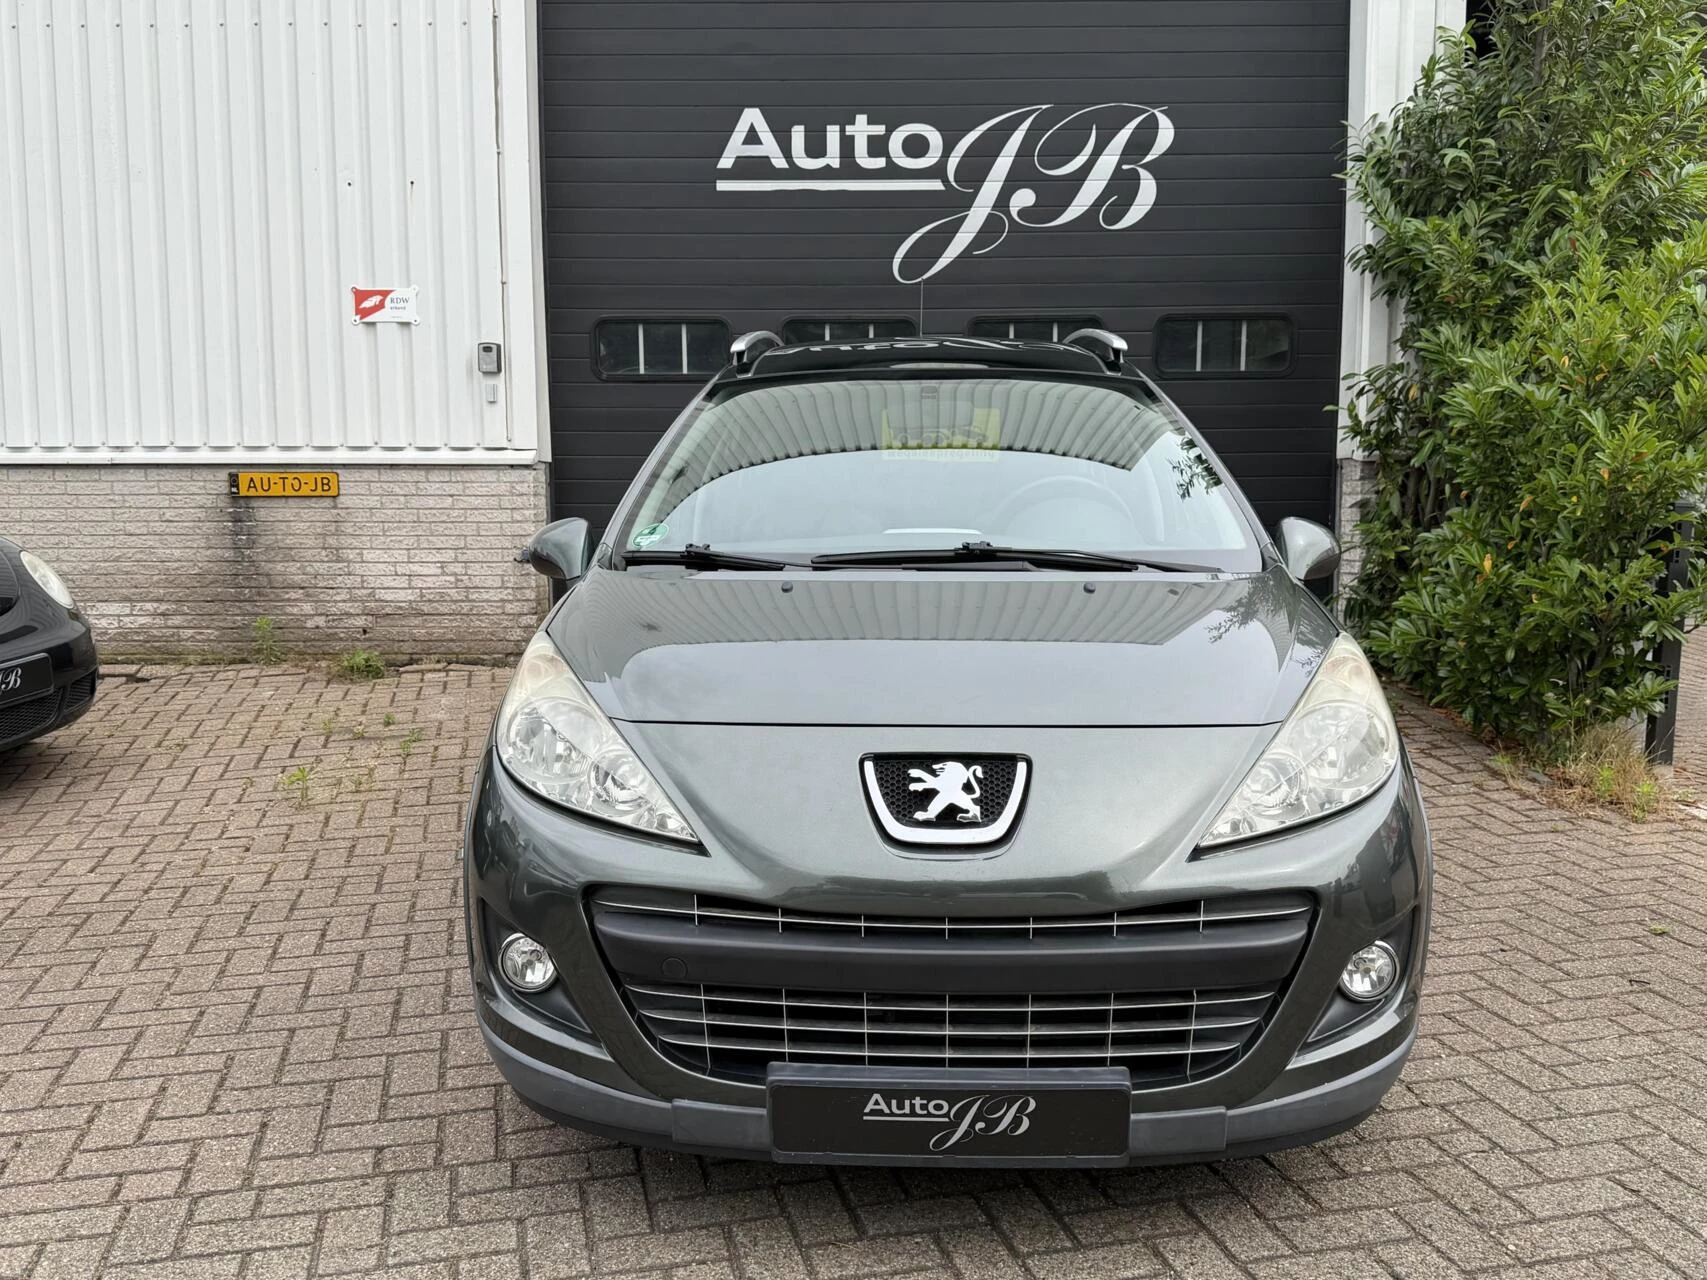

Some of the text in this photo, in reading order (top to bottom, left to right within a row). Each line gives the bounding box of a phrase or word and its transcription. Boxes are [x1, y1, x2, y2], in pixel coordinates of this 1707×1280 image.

[716, 103, 1175, 284] Auto JB
[246, 476, 332, 493] AU-TO-JB
[863, 1093, 1037, 1151] Auto JB
